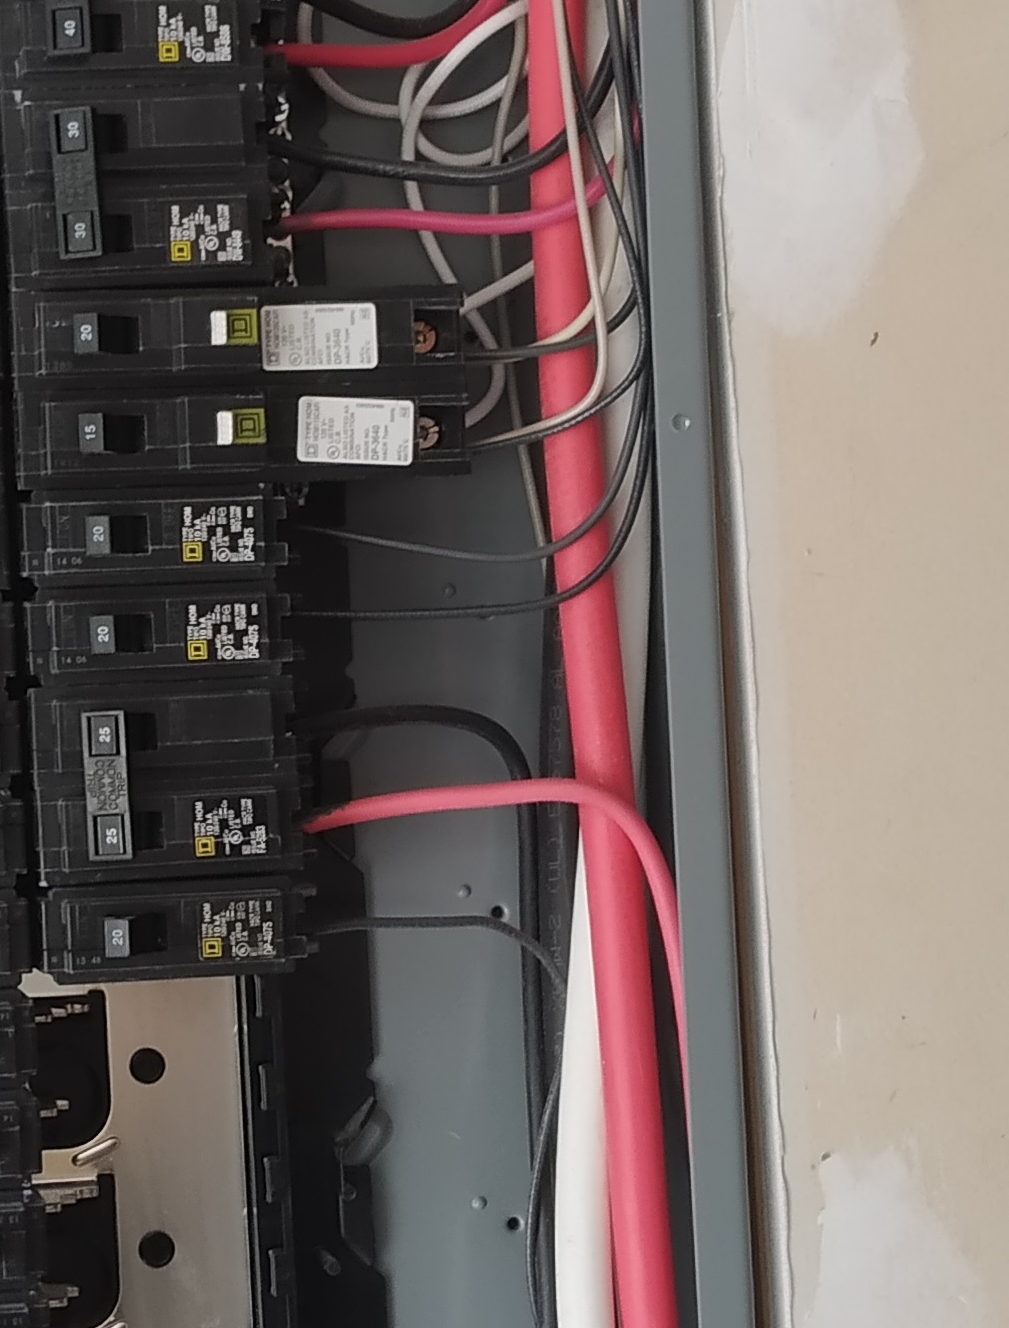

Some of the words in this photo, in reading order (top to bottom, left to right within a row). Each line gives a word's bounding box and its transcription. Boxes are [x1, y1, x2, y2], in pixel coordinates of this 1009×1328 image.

[65, 21, 75, 37] 40
[67, 121, 79, 137] 30
[75, 223, 85, 239] 30
[81, 325, 93, 341] 20
[85, 425, 95, 439] 15
[93, 525, 103, 541] 20
[97, 627, 109, 643] 20
[99, 727, 111, 743] 25
[105, 827, 117, 843] 25
[113, 929, 123, 945] 20
